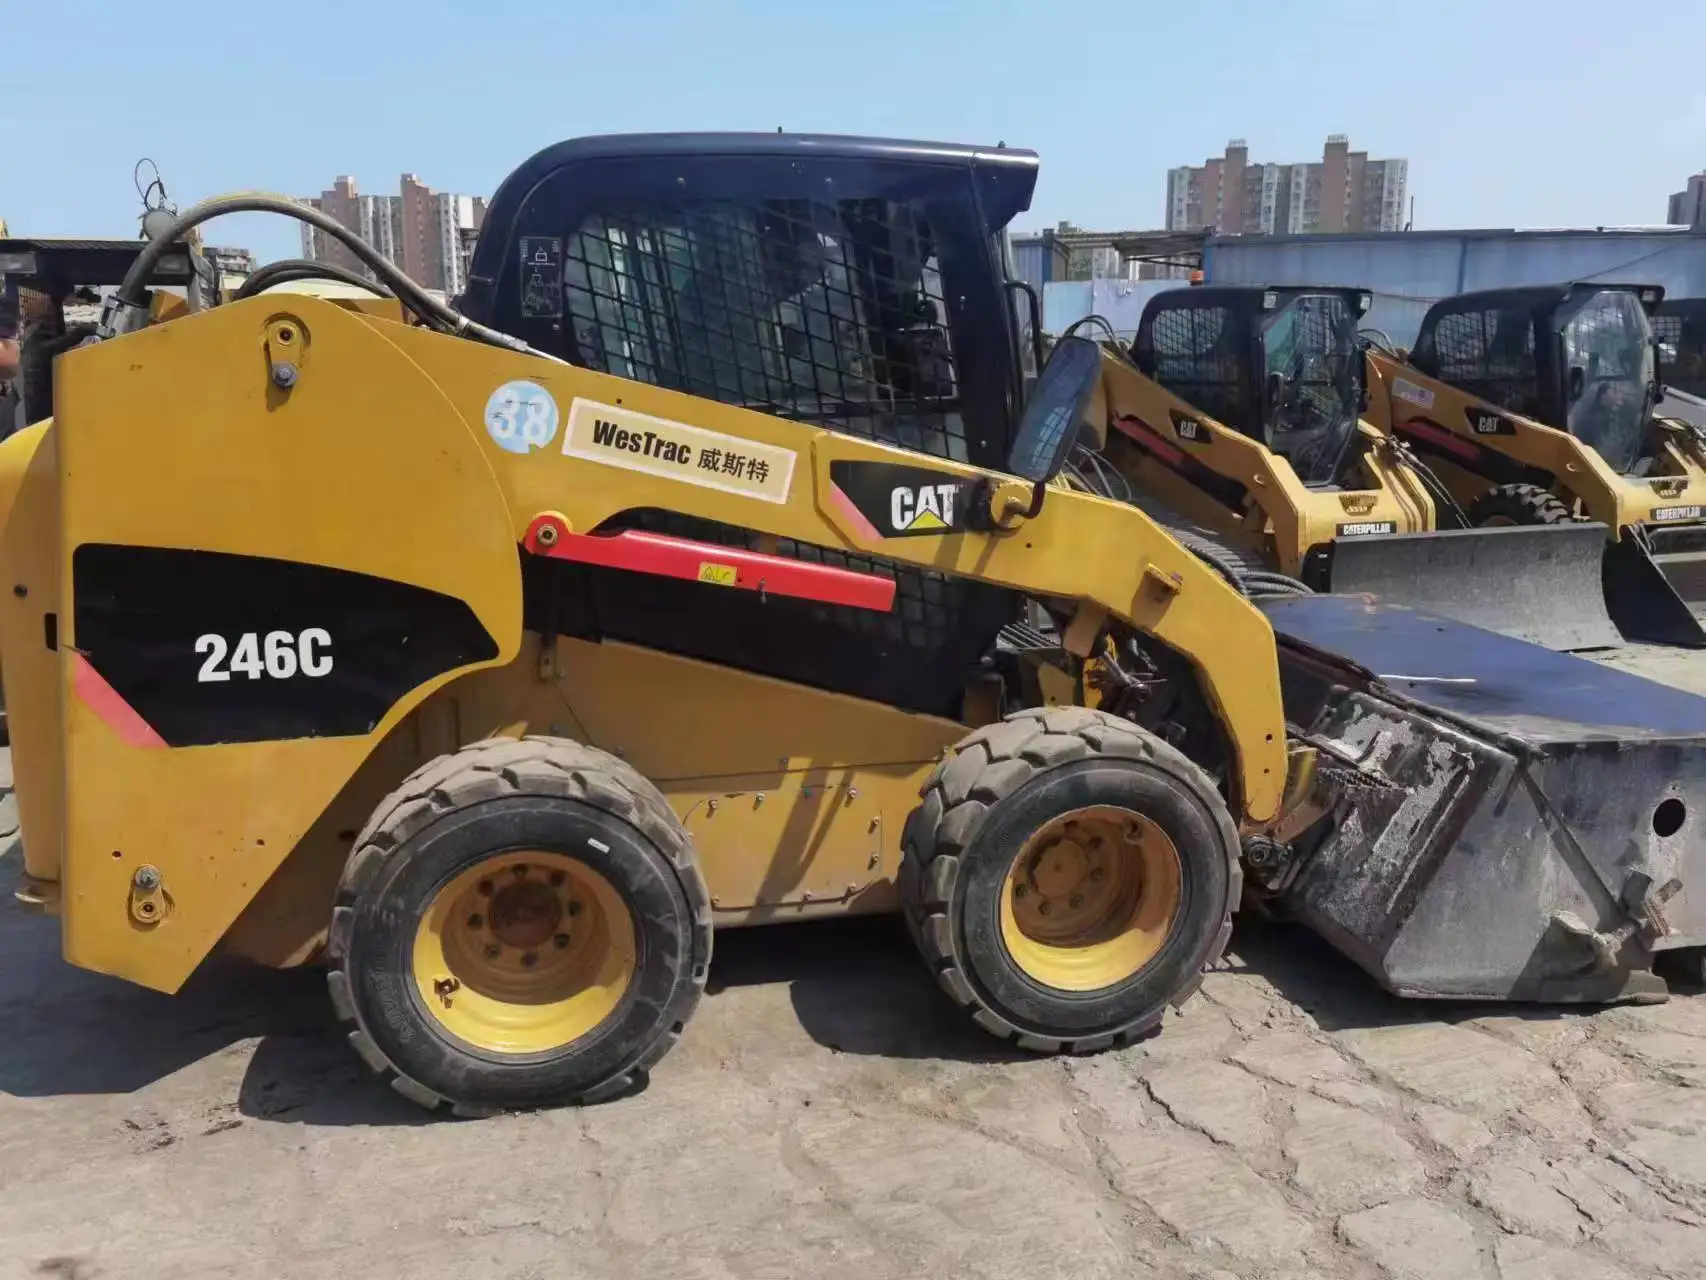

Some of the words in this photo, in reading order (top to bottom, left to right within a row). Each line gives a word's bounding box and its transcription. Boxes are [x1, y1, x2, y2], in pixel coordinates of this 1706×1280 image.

[492, 388, 550, 447] 38
[1180, 420, 1197, 439] CAT
[1479, 415, 1499, 432] CAT
[593, 419, 691, 465] WesTrac
[697, 447, 769, 484] 威斯特
[891, 484, 958, 530] CAT
[1655, 506, 1700, 520] CATERPILLAR
[1343, 523, 1390, 535] CATERPILLAR
[195, 627, 334, 683] 246C
